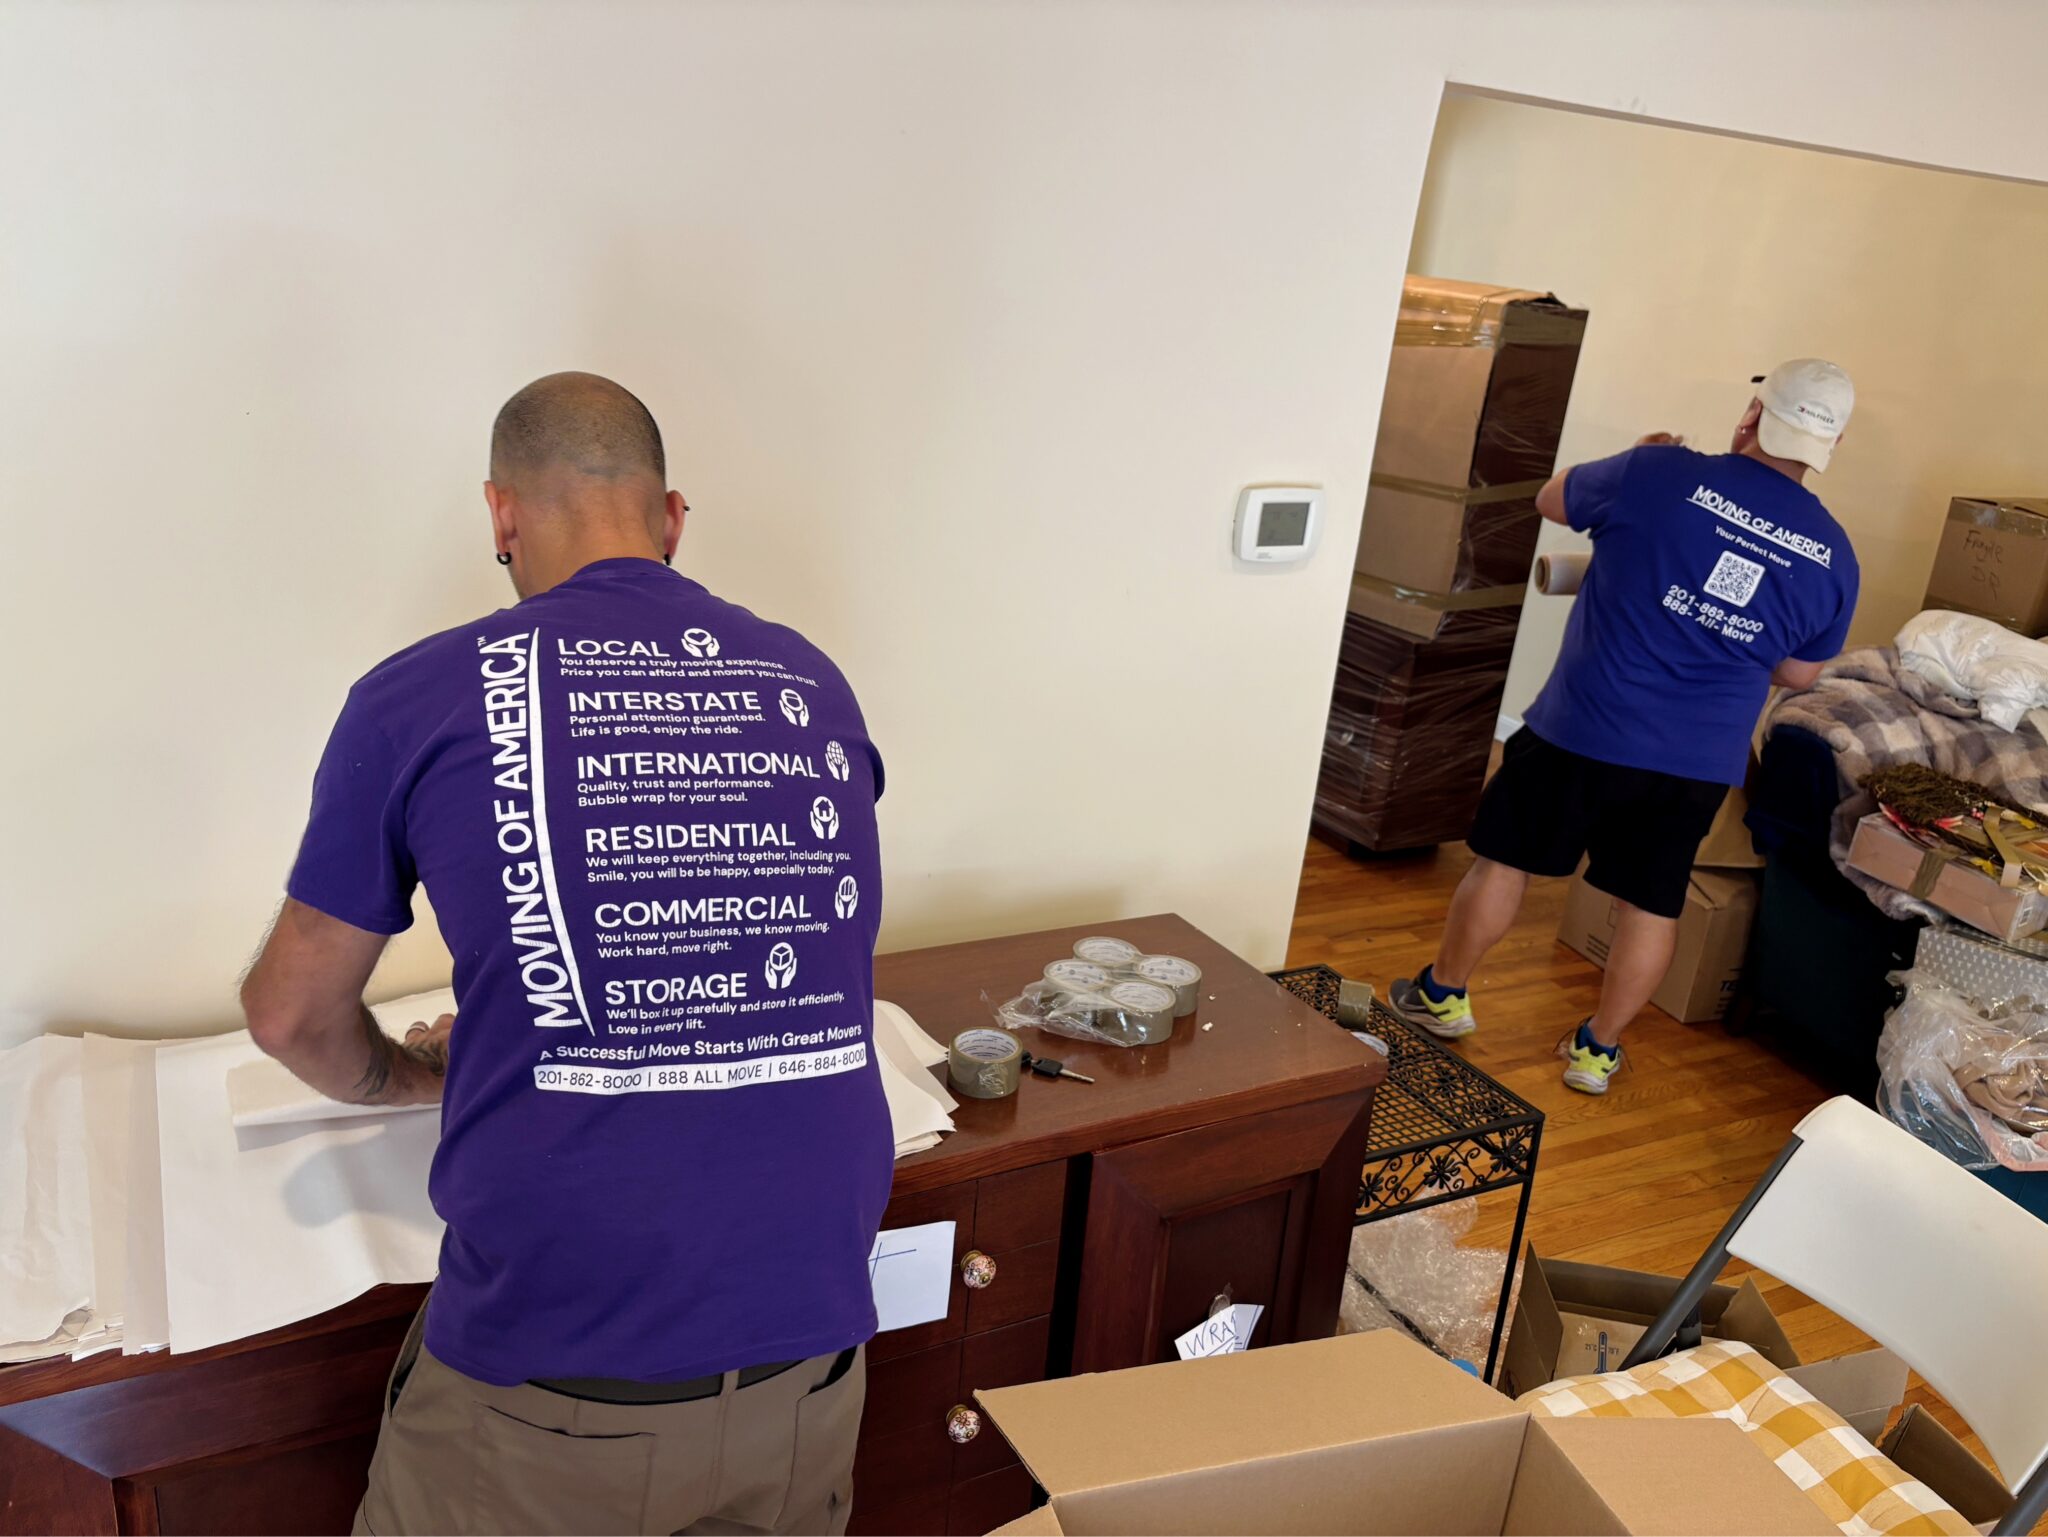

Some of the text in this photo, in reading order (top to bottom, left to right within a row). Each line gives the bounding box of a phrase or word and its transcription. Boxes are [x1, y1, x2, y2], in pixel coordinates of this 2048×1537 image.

[1692, 485, 1832, 565] MOVING OF AMERICA
[1715, 525, 1792, 568] Your Perfect Move
[1668, 585, 1764, 632] 201-862-8000
[1721, 624, 1754, 643] Move
[558, 639, 670, 657] LOCAL
[561, 668, 593, 676] Price
[596, 670, 620, 678] you
[649, 669, 685, 677] afford
[688, 669, 710, 677] and
[586, 658, 636, 666] deserve
[649, 659, 677, 668] truly
[680, 659, 724, 667] moving
[479, 633, 530, 790] AMERICA
[569, 691, 761, 712] INTERSTATE
[570, 713, 765, 725] Personal attention guaranteed.
[571, 725, 742, 737] Life is good, enjoy the ride.
[578, 752, 820, 779] INTERNATIONAL
[577, 778, 773, 794] Quality, trust and performance.
[578, 792, 748, 807] Bubble wrap for your soul.
[494, 800, 533, 854] OF
[586, 823, 796, 853] RESIDENTIAL
[586, 850, 850, 867] We will keep everything together, including you.
[588, 864, 834, 882] Smile, you will be be happy, especially today.
[595, 895, 811, 928] COMMERCIAL
[596, 921, 829, 943] You know your business, we know moving.
[502, 861, 583, 1027] MOVING
[598, 940, 732, 958] Work hard, move right.
[605, 973, 747, 1005] STORAGE
[640, 1009, 660, 1019] box
[662, 1008, 669, 1017] it
[671, 1008, 684, 1017] up
[687, 1002, 737, 1015] carefully
[740, 1000, 760, 1012] and
[762, 1000, 786, 1010] store
[789, 997, 796, 1006] it
[608, 1019, 705, 1034] Love in every lift.
[540, 1025, 862, 1060] A Successful Move Starts With Great Movers
[538, 1070, 642, 1089] 201-862-8000
[658, 1071, 688, 1085] 888
[694, 1070, 722, 1083] ALL
[728, 1064, 762, 1082] MOVE
[779, 1049, 865, 1075] 646-884-8000
